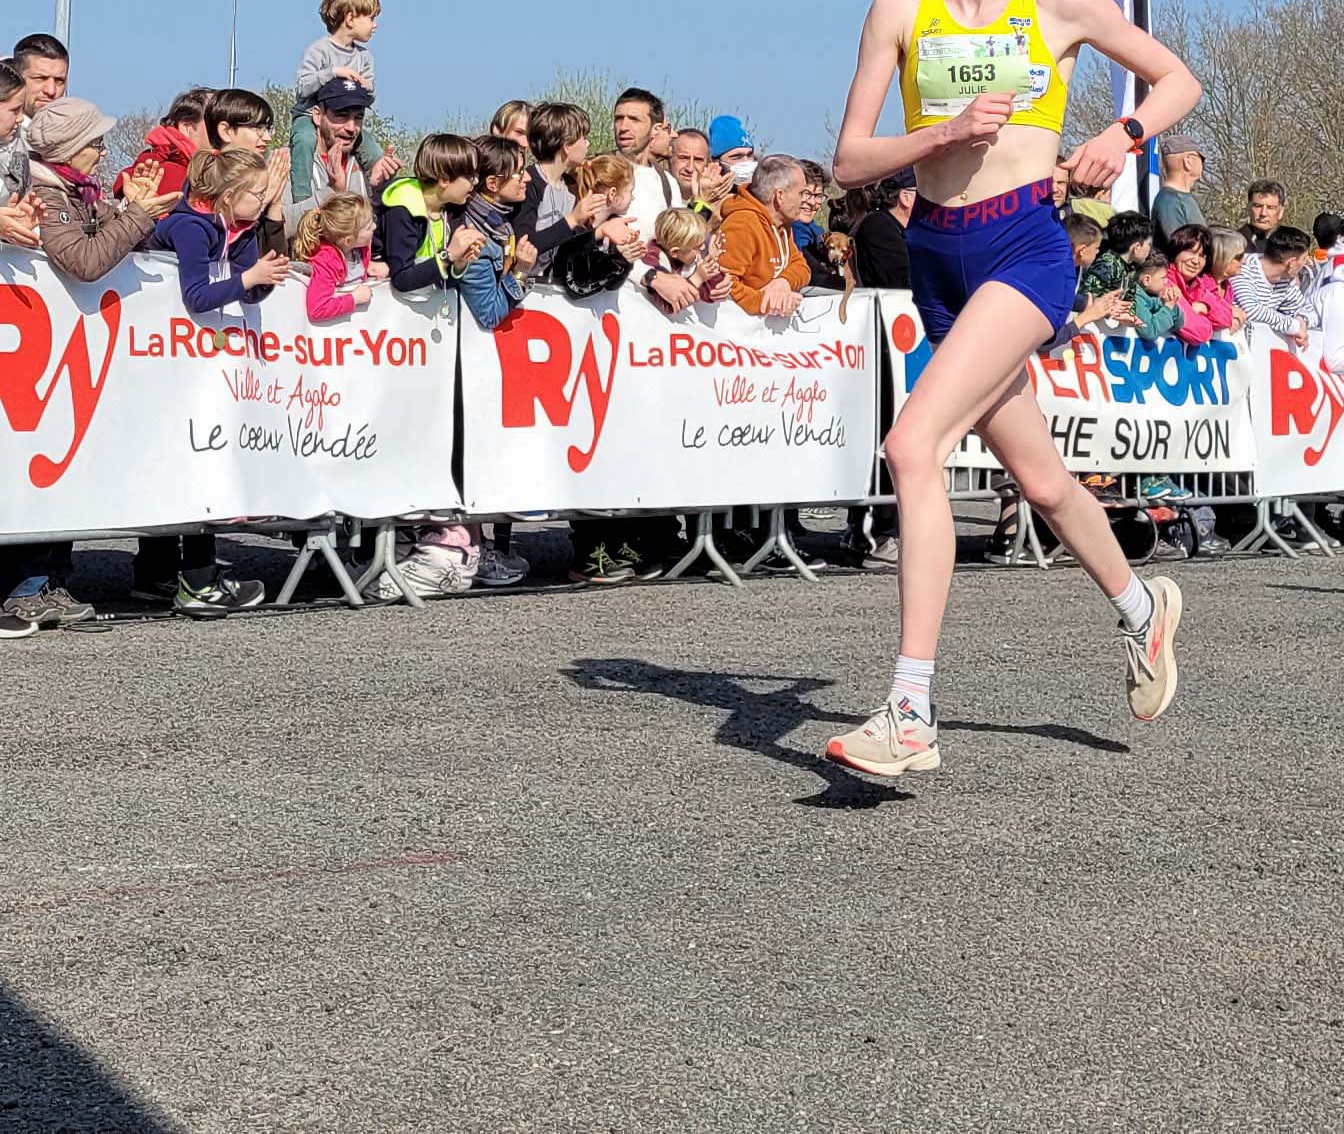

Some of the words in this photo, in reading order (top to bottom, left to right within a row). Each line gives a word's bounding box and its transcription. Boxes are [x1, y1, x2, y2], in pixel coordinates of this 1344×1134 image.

[947, 64, 996, 83] 1653
[959, 86, 988, 95] JULIE
[964, 191, 1019, 227] PRO
[128, 325, 165, 357] La
[169, 318, 427, 366] Roche-sur-Yon
[628, 341, 665, 367] La
[669, 333, 866, 370] Roche-sur-Yon
[1025, 332, 1238, 406] ERSPORT
[222, 367, 262, 403] Ville
[267, 378, 285, 405] et
[286, 375, 342, 430] Agglo
[493, 309, 620, 474] Ry
[713, 375, 757, 407] Ville
[762, 380, 780, 403] et
[781, 376, 828, 424] Agglo
[189, 418, 229, 453] Le
[288, 414, 378, 460] Vendée
[682, 418, 707, 448] Le
[1111, 417, 1172, 460] SUR
[1184, 418, 1231, 460] YON
